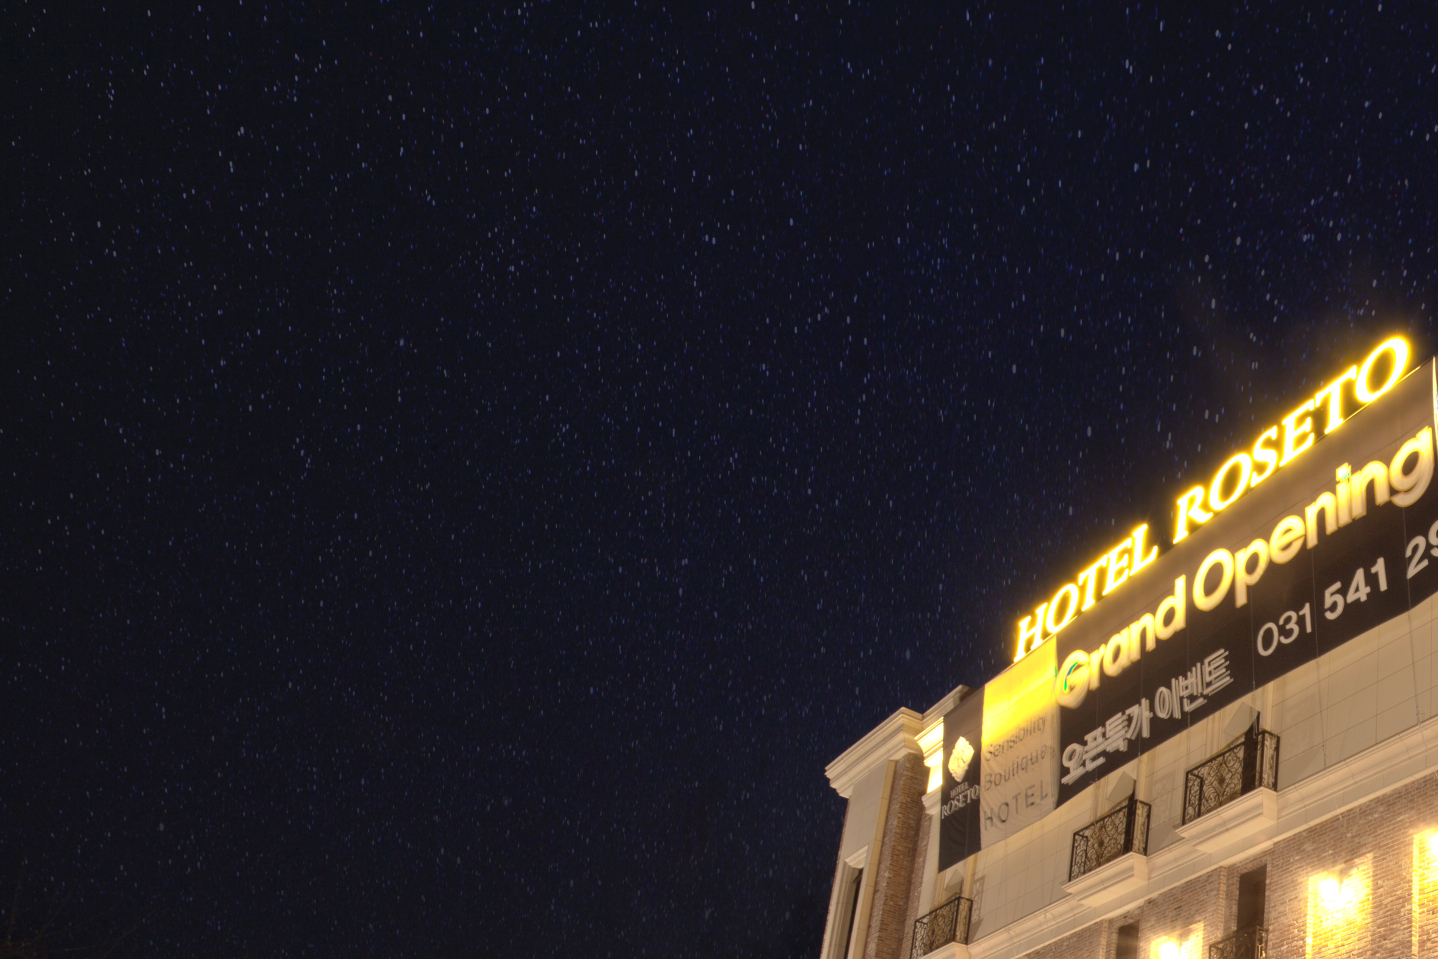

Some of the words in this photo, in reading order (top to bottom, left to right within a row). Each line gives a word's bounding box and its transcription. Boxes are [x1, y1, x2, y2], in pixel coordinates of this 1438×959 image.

[1013, 522, 1160, 664] HOTEL
[1171, 334, 1411, 545] ROSETO
[1056, 574, 1187, 710] Grand
[1192, 426, 1435, 609] Opening
[1257, 602, 1312, 657] 031
[1324, 556, 1388, 620] 541
[984, 713, 1048, 762] Sensibility
[1061, 697, 1154, 785] 오픈특가
[1154, 648, 1235, 720] 이벤트
[950, 781, 969, 797] HOTEL
[984, 743, 1049, 792] Boutique
[941, 784, 981, 819] ROSETO
[983, 779, 1048, 831] HOTEL
